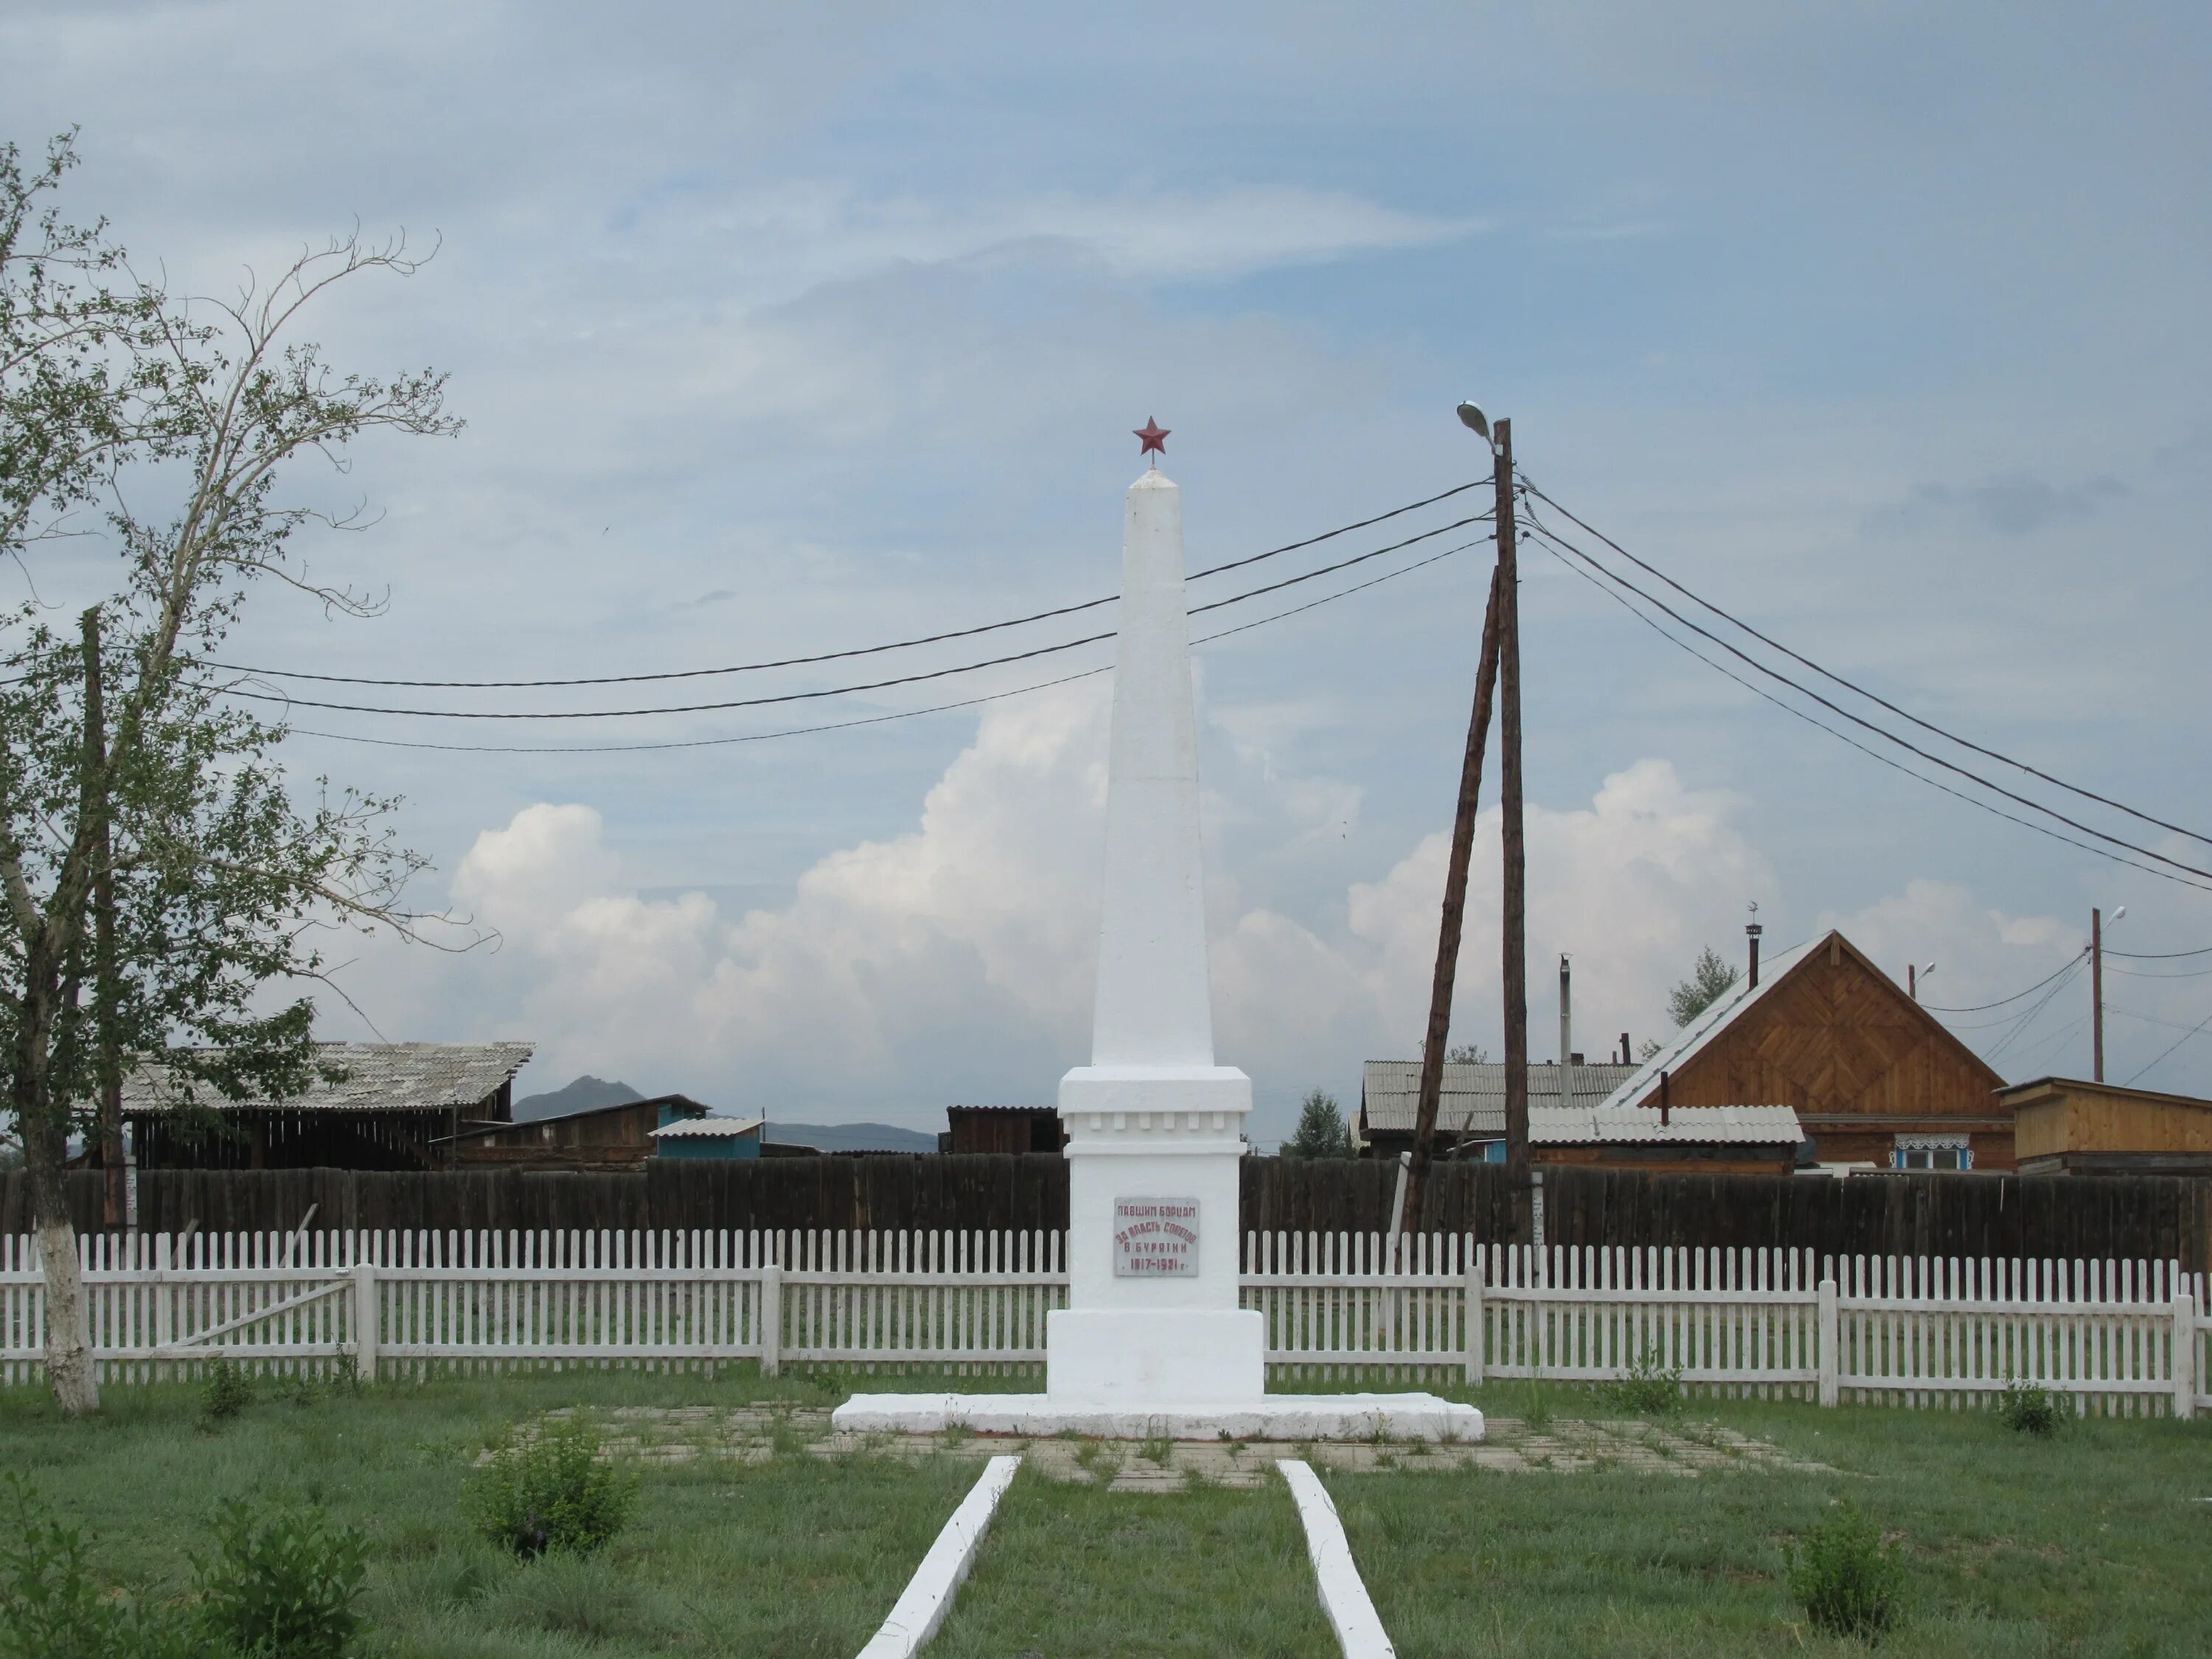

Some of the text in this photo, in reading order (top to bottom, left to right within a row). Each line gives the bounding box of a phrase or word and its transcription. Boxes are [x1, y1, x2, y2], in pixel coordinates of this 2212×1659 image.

[1118, 1205, 1195, 1218] ПАВШИМ БОРЦАМ
[1115, 1221, 1197, 1244] ЗА ВЛАСТЬ СОВЕТОВ
[1124, 1242, 1186, 1253] В БУРЯТИИ
[1130, 1258, 1178, 1270] 1917-1921
